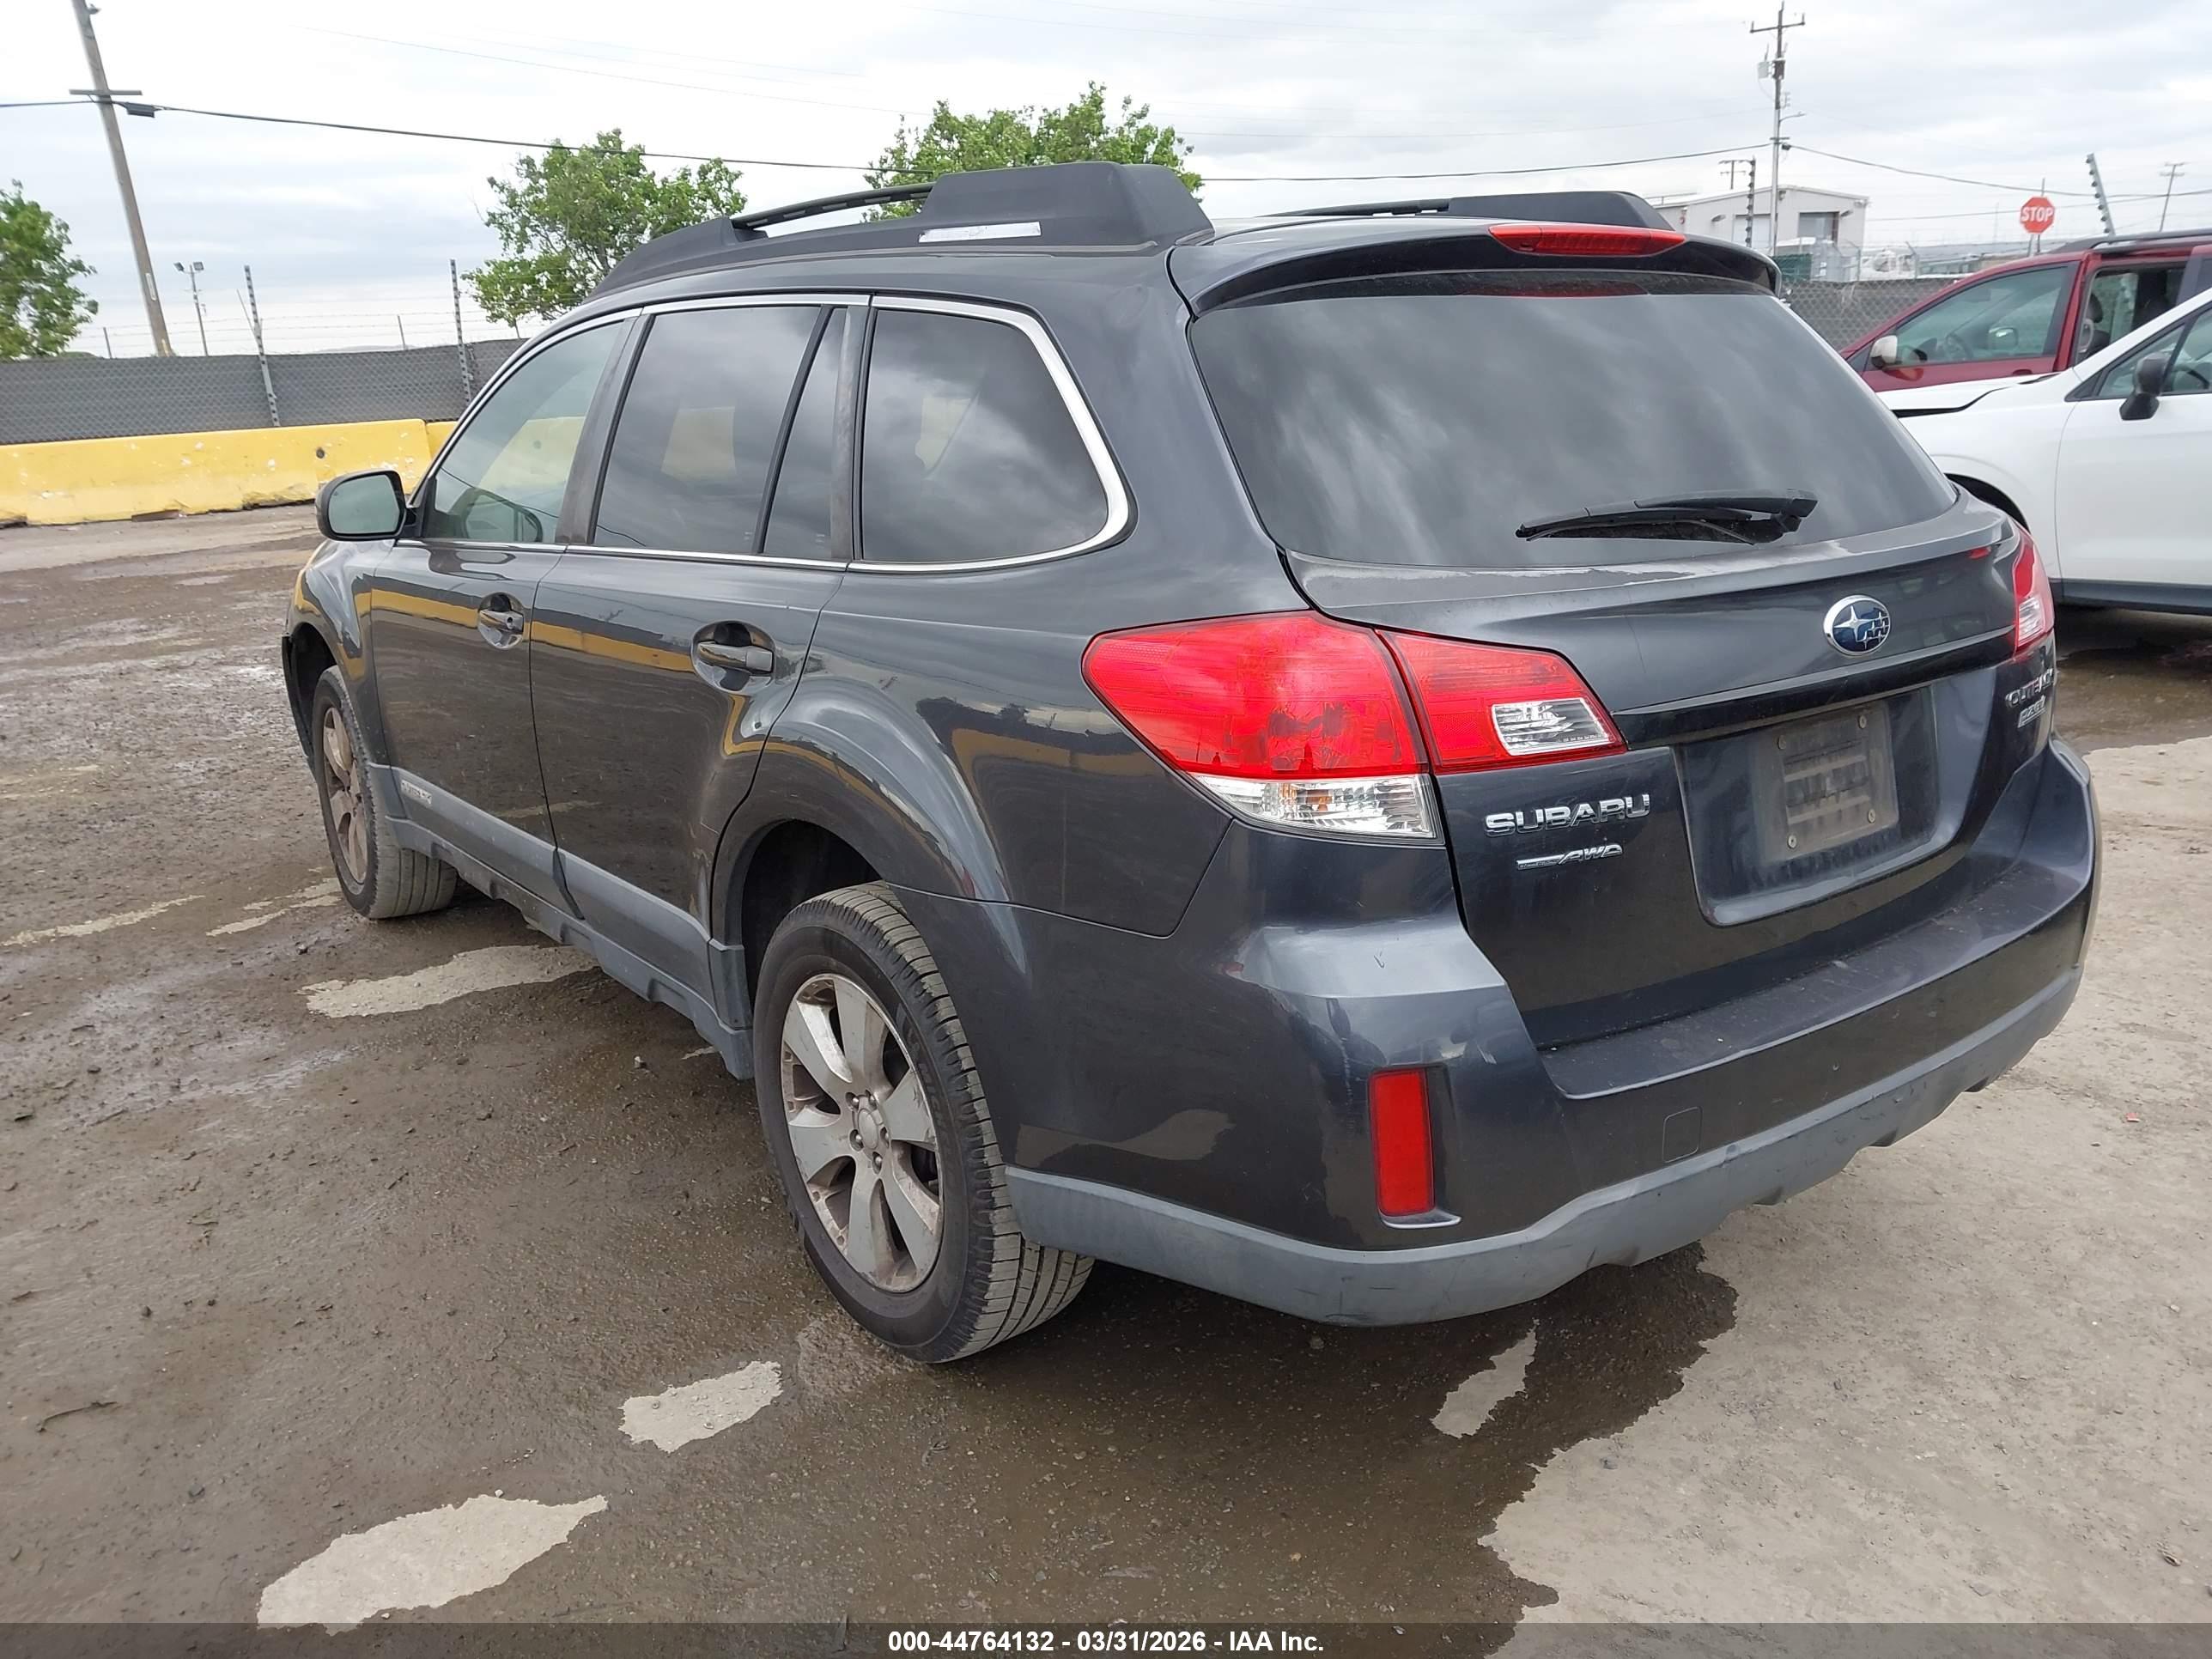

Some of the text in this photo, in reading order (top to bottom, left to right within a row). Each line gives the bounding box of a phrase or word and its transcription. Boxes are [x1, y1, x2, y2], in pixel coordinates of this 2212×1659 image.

[2021, 205, 2054, 223] STOP
[1485, 793, 1651, 836] SUBARU
[1558, 844, 1623, 866] AWD
